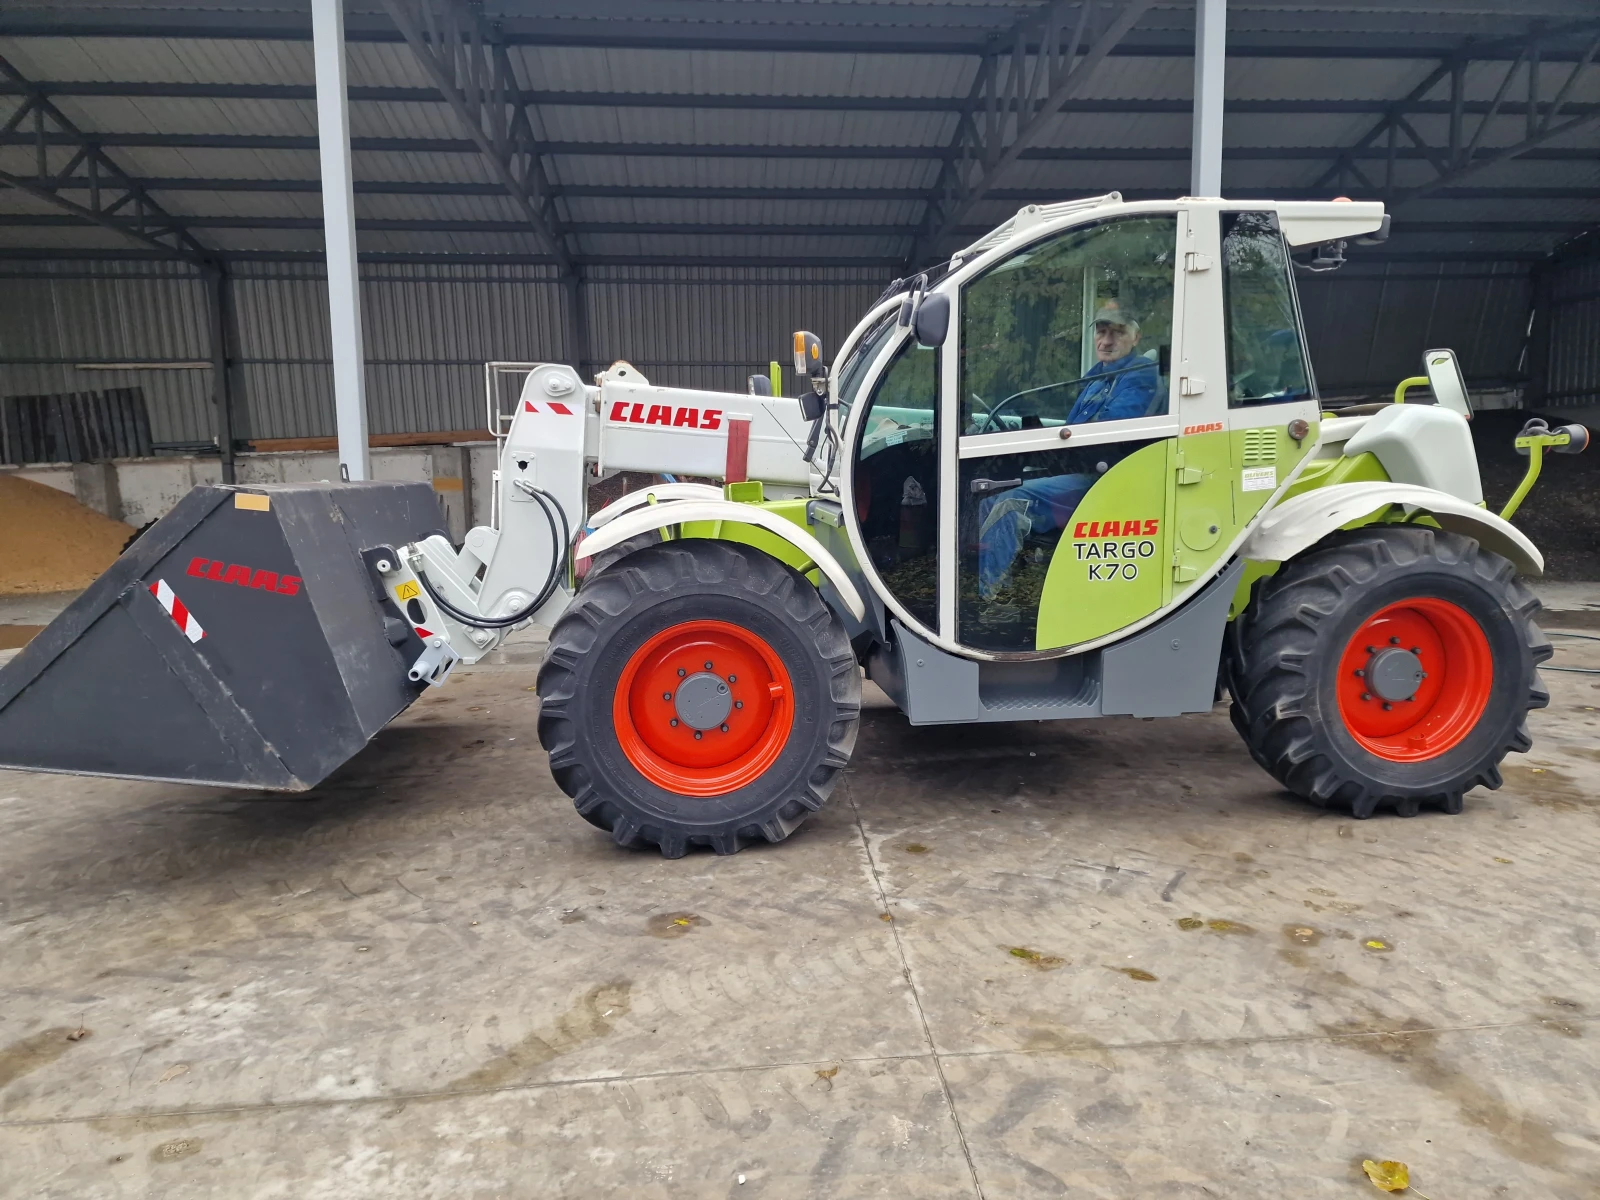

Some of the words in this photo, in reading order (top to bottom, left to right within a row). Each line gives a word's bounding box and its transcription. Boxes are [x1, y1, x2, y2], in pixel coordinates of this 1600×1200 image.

[609, 401, 723, 430] CLAAS
[1184, 421, 1223, 436] CLAAS
[1073, 519, 1159, 539] CLAAS
[1072, 540, 1155, 560] TARGO
[186, 557, 302, 596] CLAAS
[1088, 563, 1138, 581] K70
